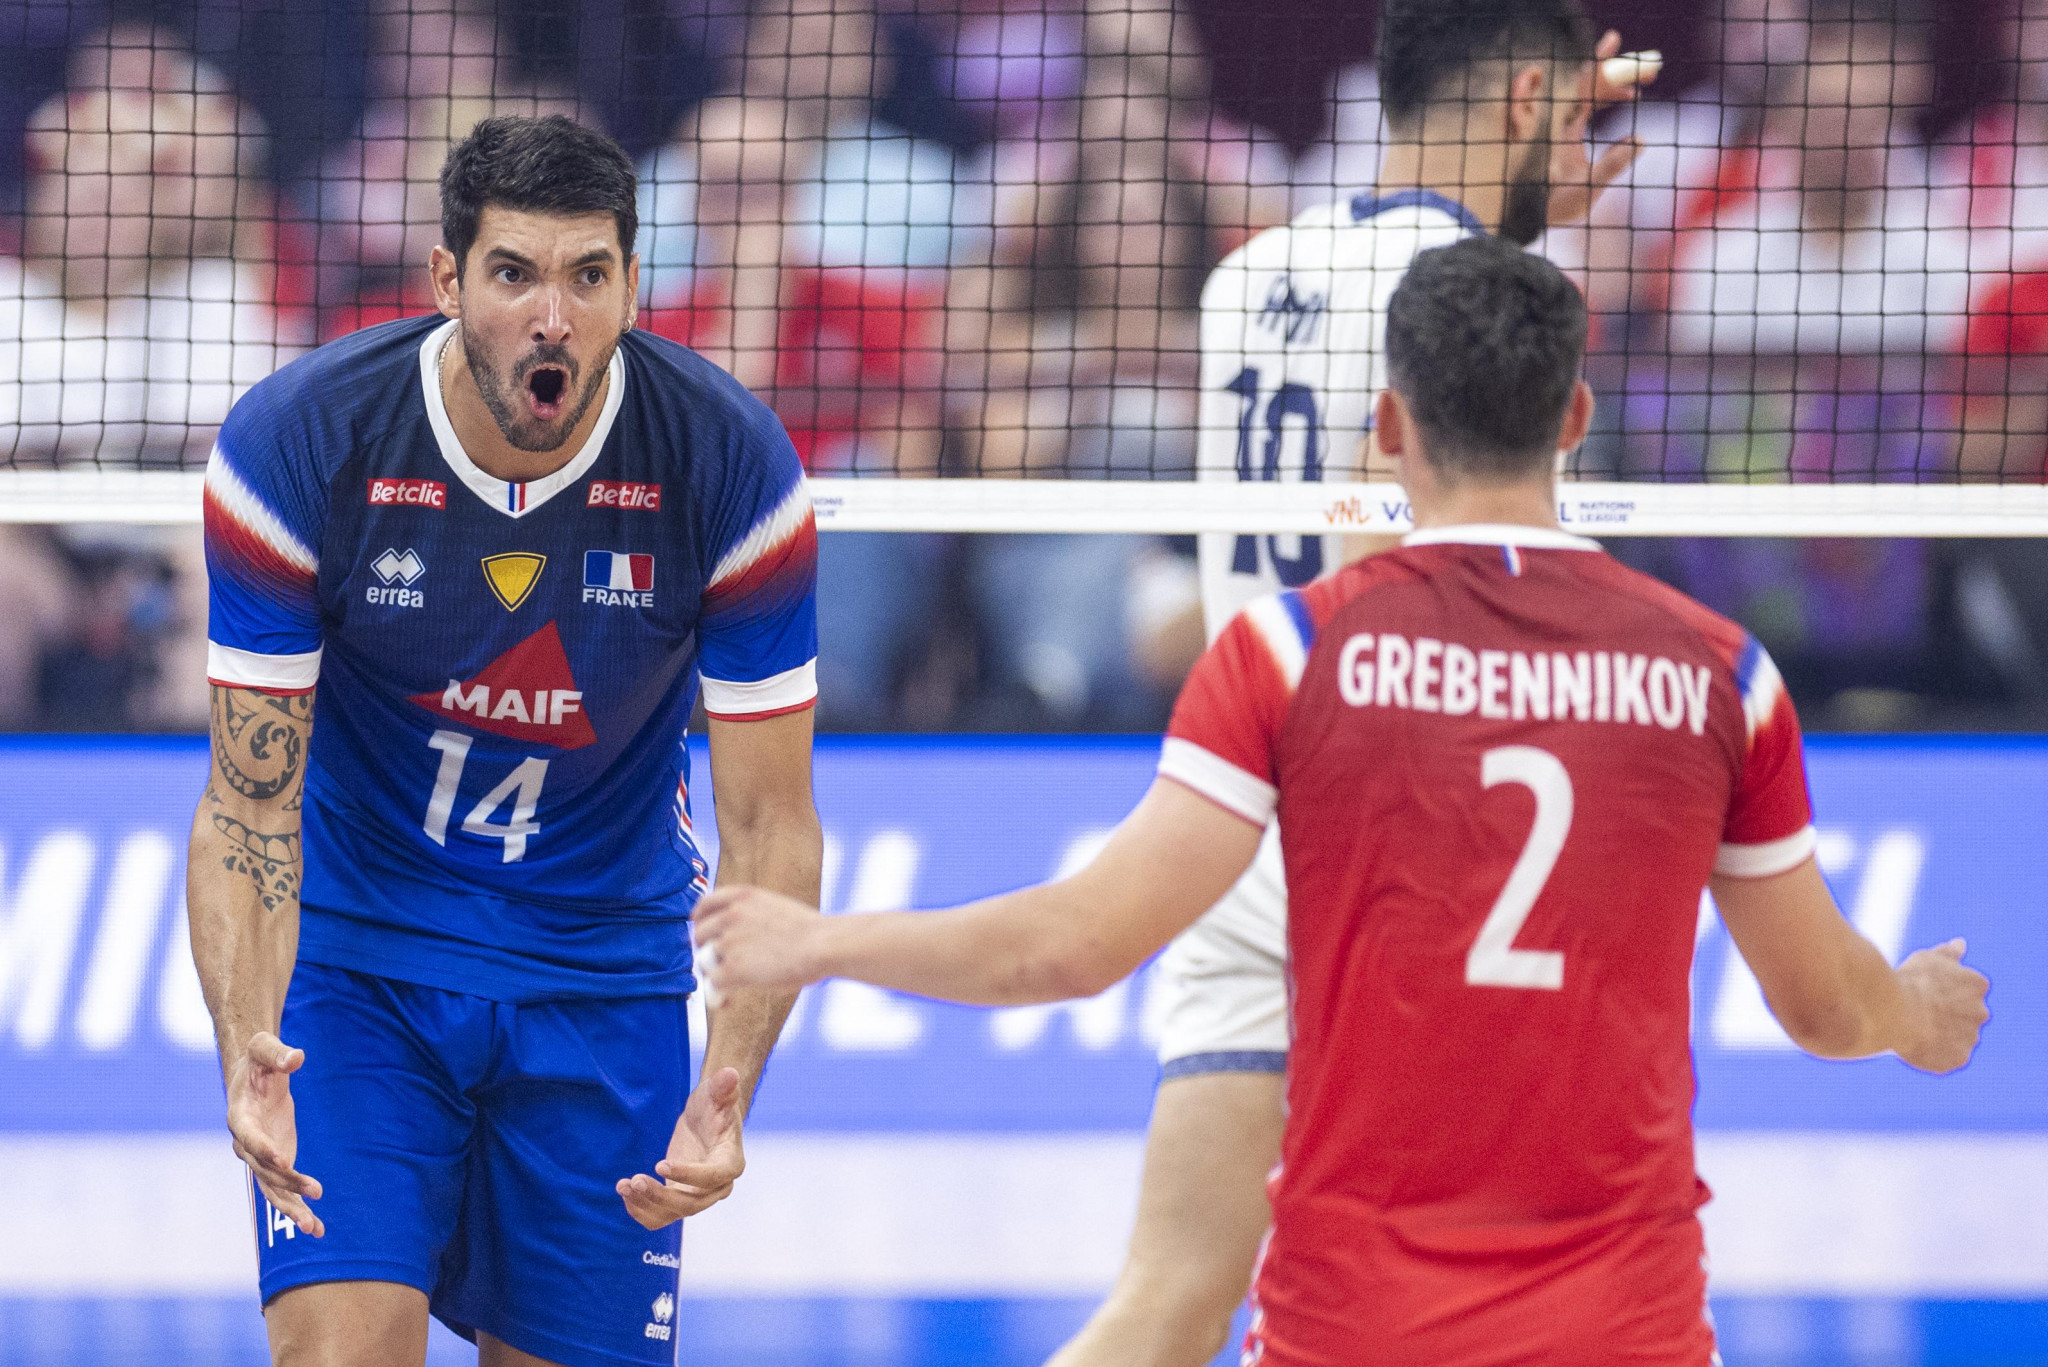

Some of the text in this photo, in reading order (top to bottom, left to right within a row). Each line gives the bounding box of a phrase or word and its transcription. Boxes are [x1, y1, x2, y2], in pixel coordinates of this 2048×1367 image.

[370, 481, 443, 506] Betclic
[588, 483, 659, 508] Betlic
[441, 678, 584, 726] MAIF
[1337, 632, 1712, 736] GREBENNIKOV
[422, 728, 551, 864] 14
[1464, 744, 1576, 991] 2
